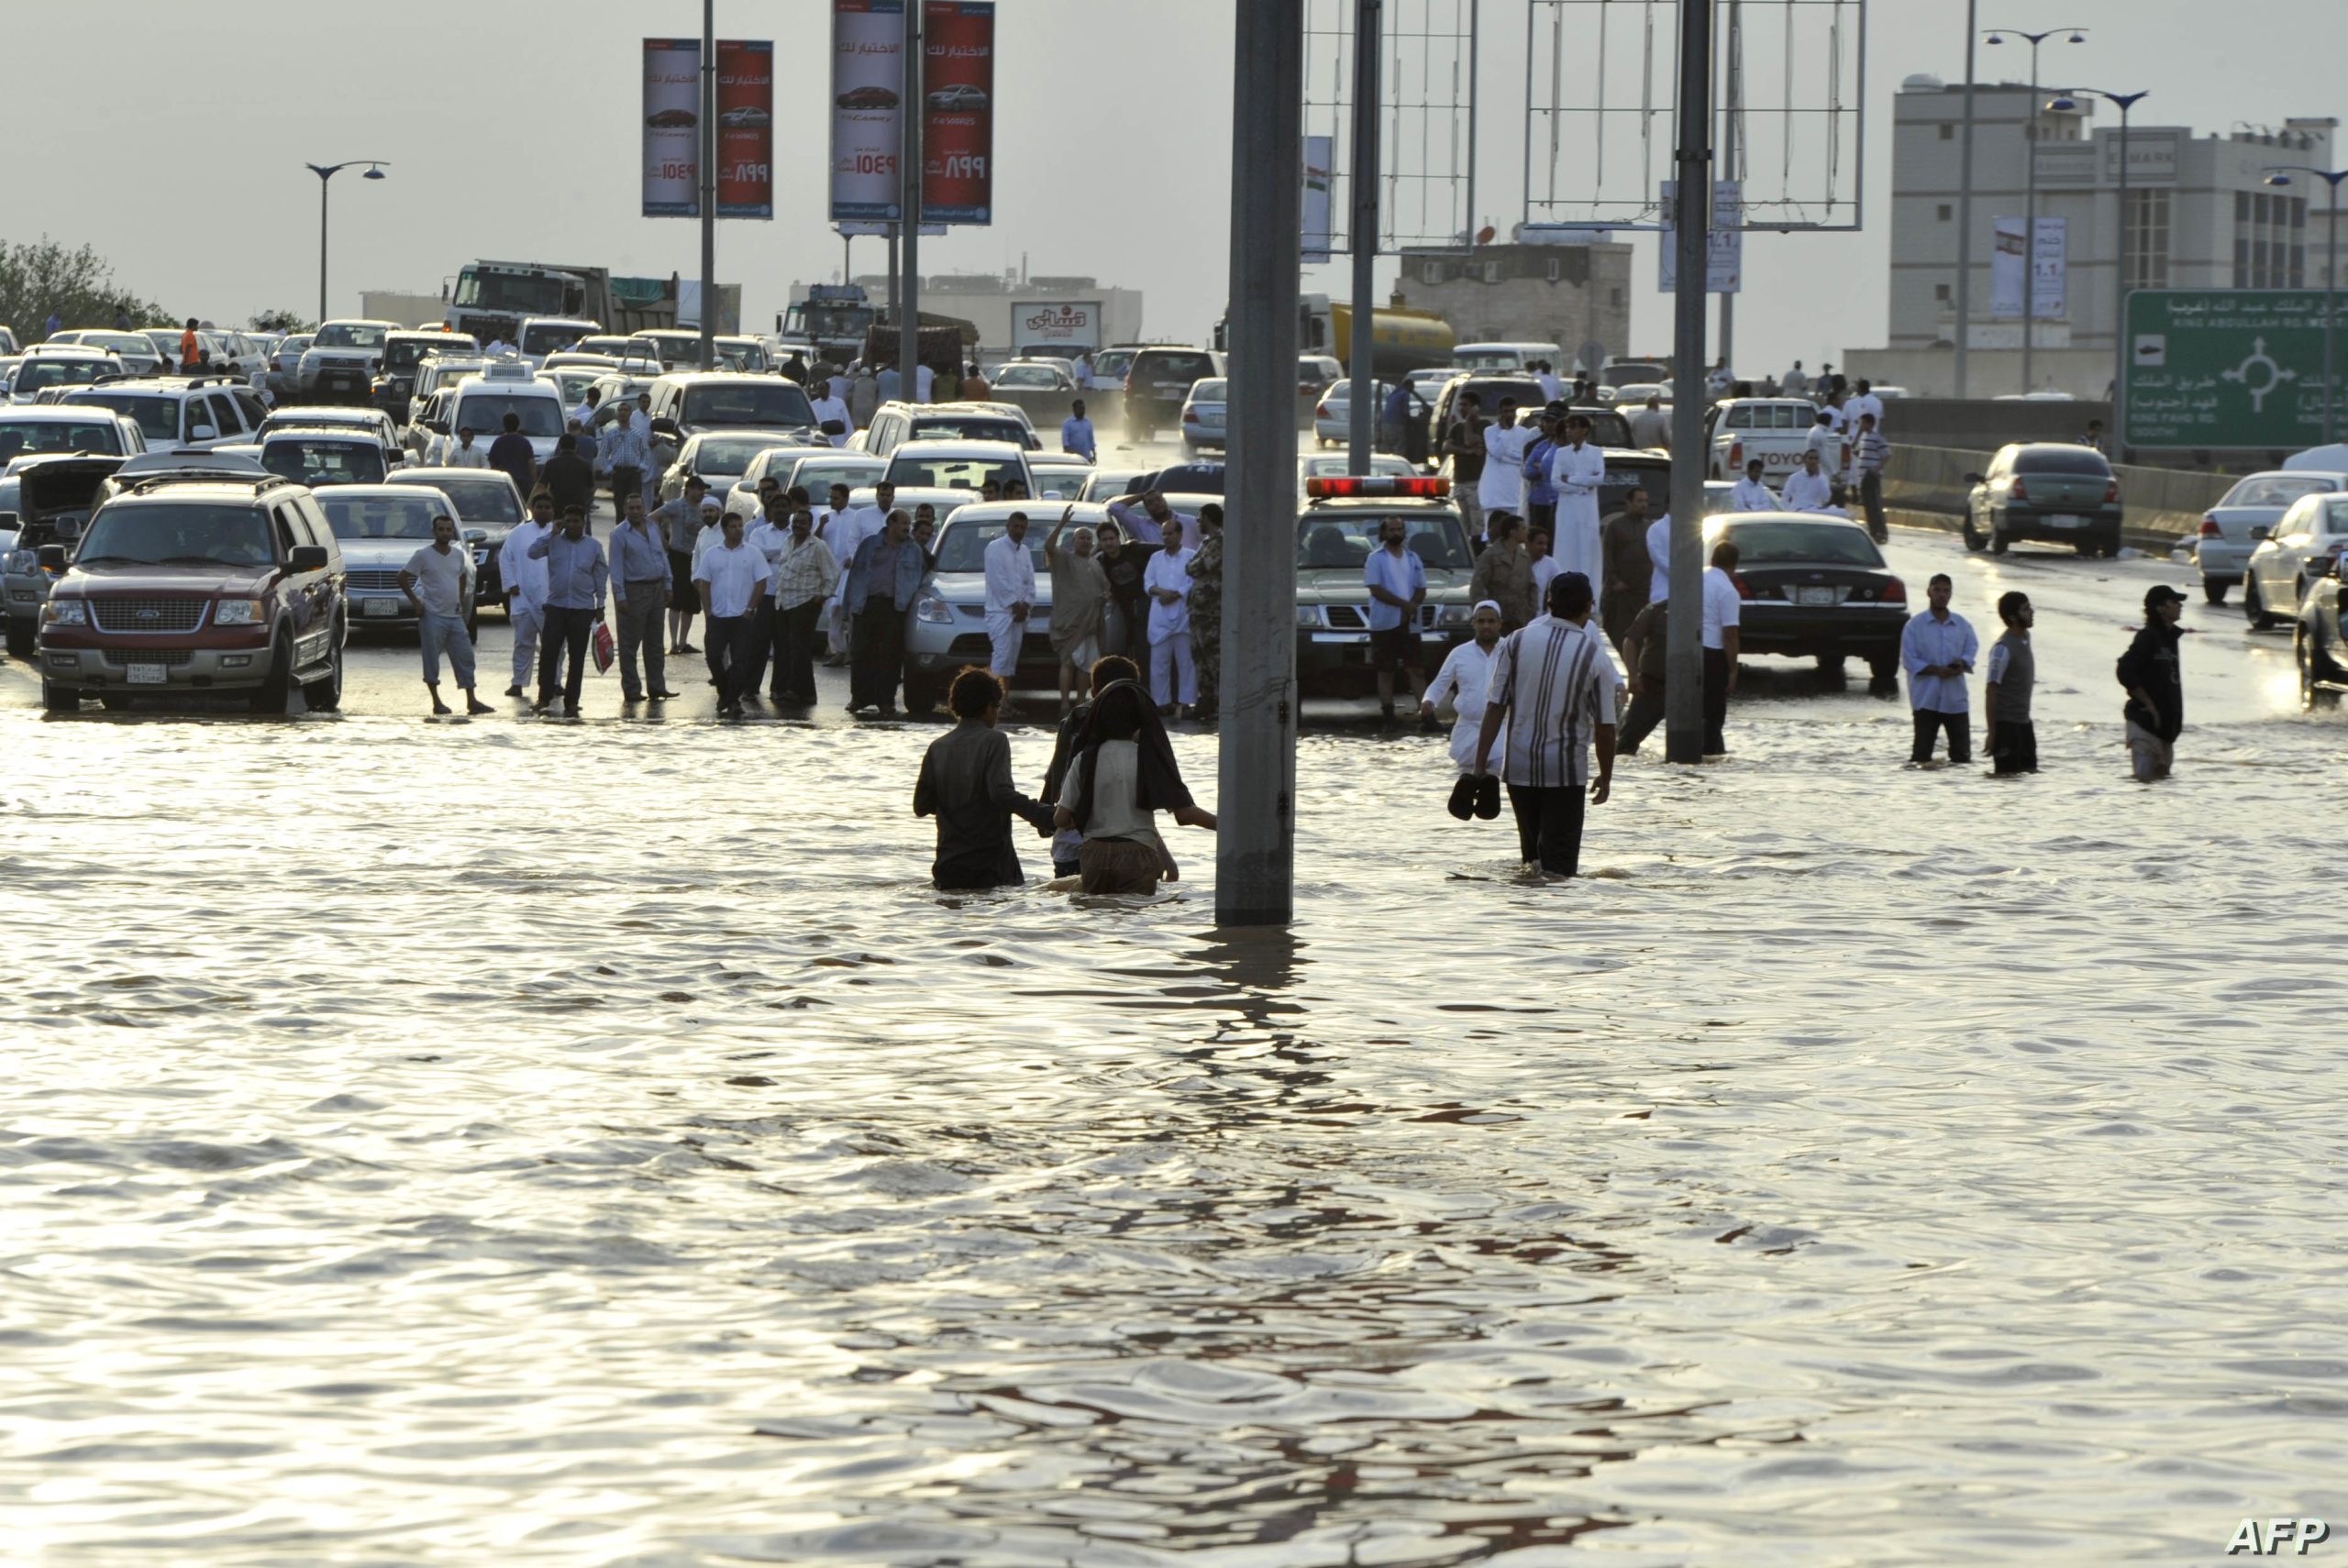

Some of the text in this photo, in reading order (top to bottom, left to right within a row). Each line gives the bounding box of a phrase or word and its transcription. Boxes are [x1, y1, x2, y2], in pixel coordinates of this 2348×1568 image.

[926, 45, 991, 59] الاختيار لك
[1758, 453, 1805, 466] TOYO
